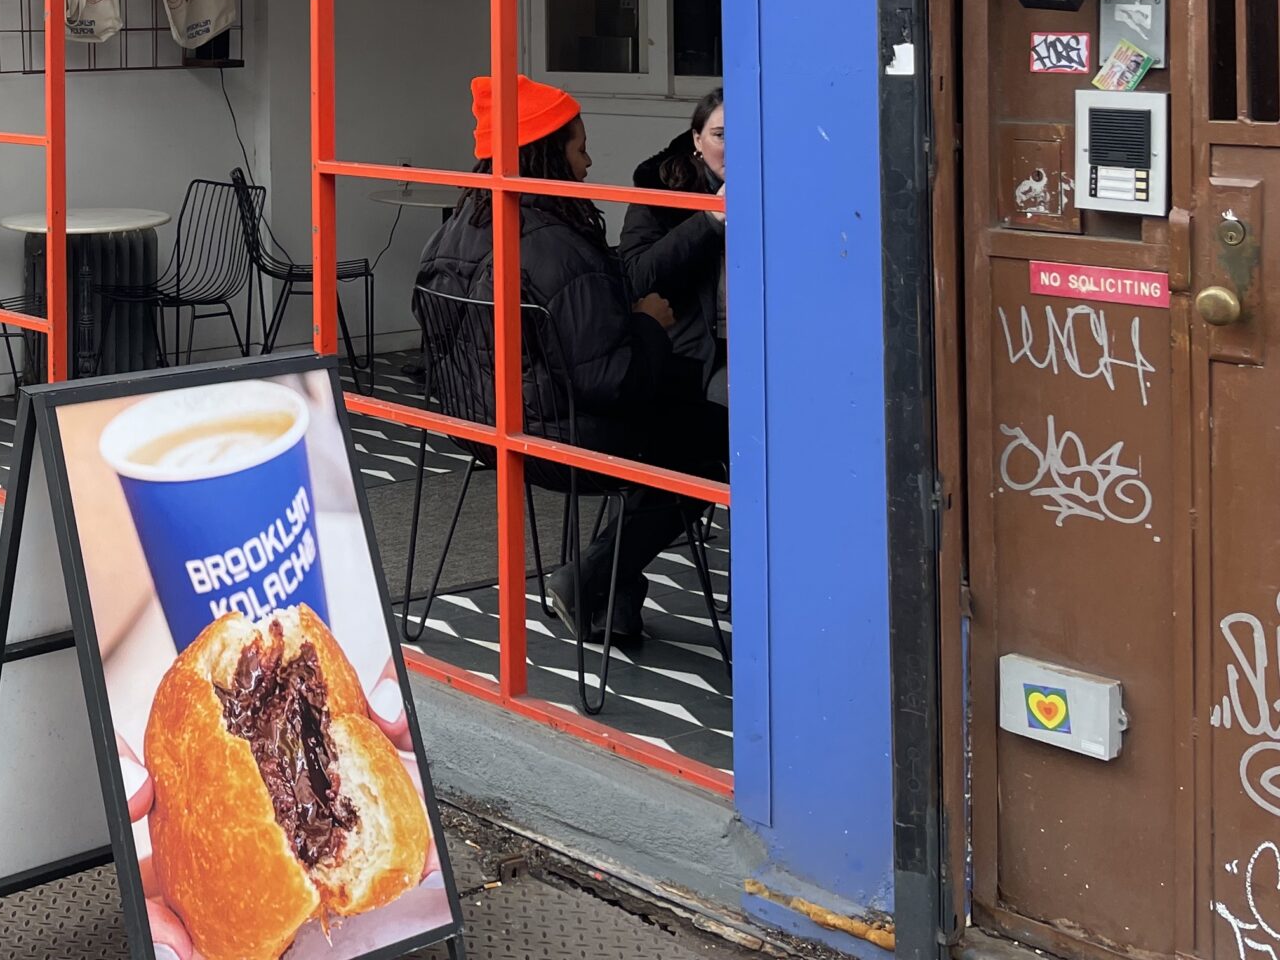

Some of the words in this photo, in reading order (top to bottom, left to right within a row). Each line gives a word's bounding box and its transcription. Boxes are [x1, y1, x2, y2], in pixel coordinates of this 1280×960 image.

[1040, 271, 1061, 287] NO
[1068, 274, 1161, 298] SOLICITING
[185, 486, 310, 594] BROOKLYN
